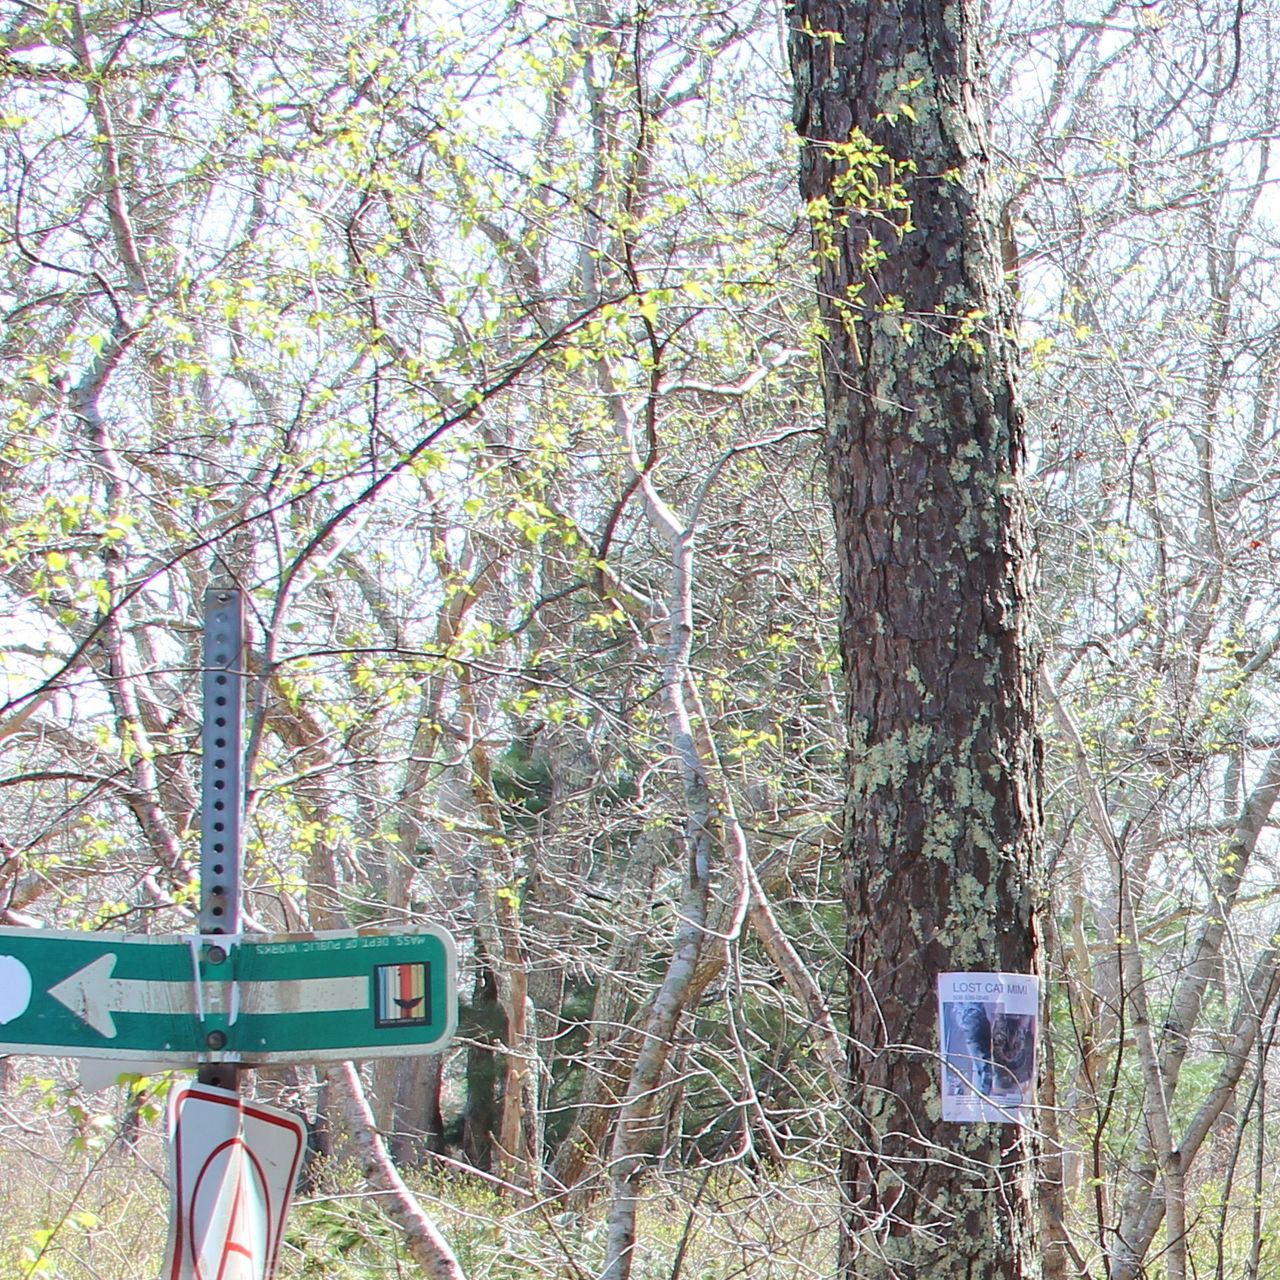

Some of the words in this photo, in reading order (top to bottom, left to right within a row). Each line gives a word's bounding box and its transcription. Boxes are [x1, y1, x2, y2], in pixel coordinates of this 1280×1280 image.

[303, 941, 341, 951] PUBLIC
[345, 941, 358, 949] OF
[362, 938, 389, 948] DEPT.
[256, 944, 298, 954] WORKS
[952, 982, 982, 993] LOST
[985, 982, 1003, 993] CAT
[1007, 984, 1027, 995] MIMI
